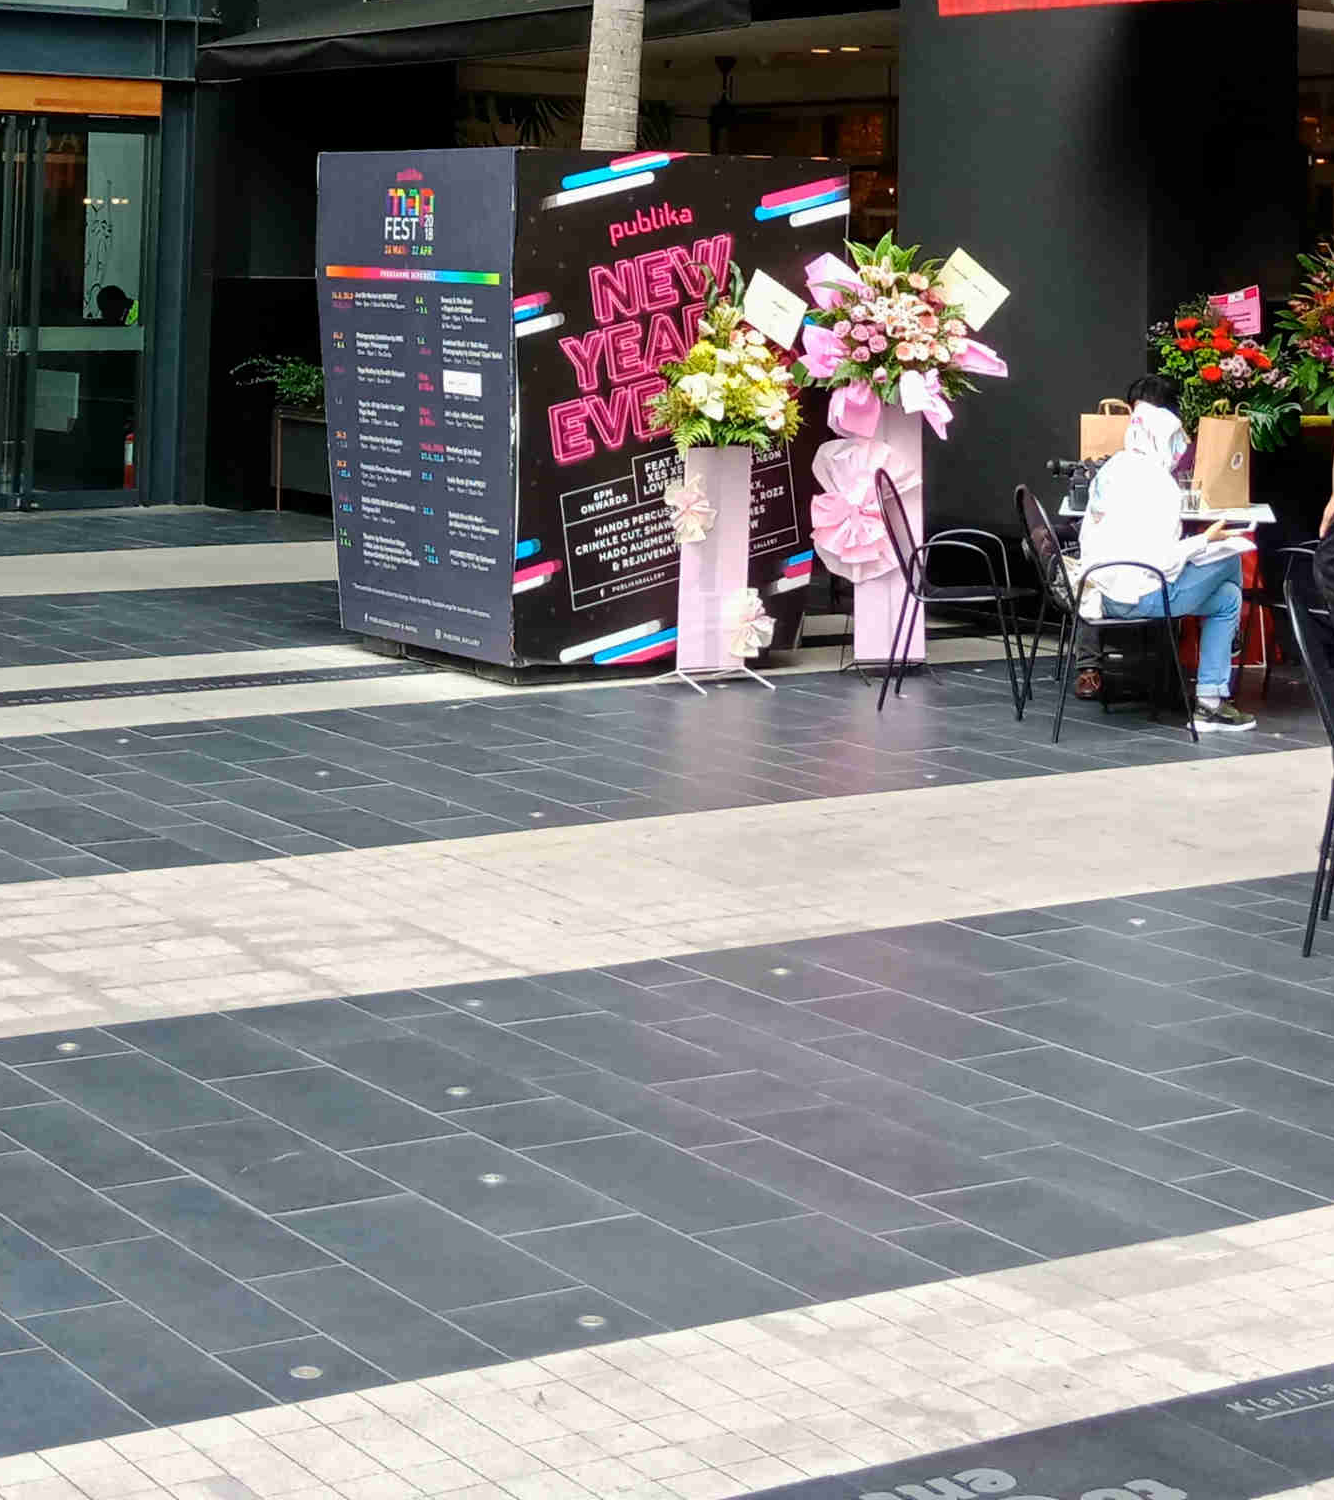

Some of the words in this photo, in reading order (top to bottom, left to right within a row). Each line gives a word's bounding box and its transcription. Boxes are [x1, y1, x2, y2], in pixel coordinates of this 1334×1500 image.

[384, 217, 419, 241] FEST
[609, 202, 694, 247] publika
[588, 234, 732, 323] NEW
[547, 377, 673, 465] EVE
[647, 469, 668, 484] XES
[580, 493, 629, 515] ONWARDS
[593, 488, 614, 501] 6PM
[594, 520, 630, 537] HANDS
[632, 506, 677, 524] PERCUSS
[575, 537, 618, 556] CRINKLE
[599, 546, 629, 563] HADO
[630, 531, 677, 553] AUGMENT
[622, 545, 680, 568] REJUVENAT
